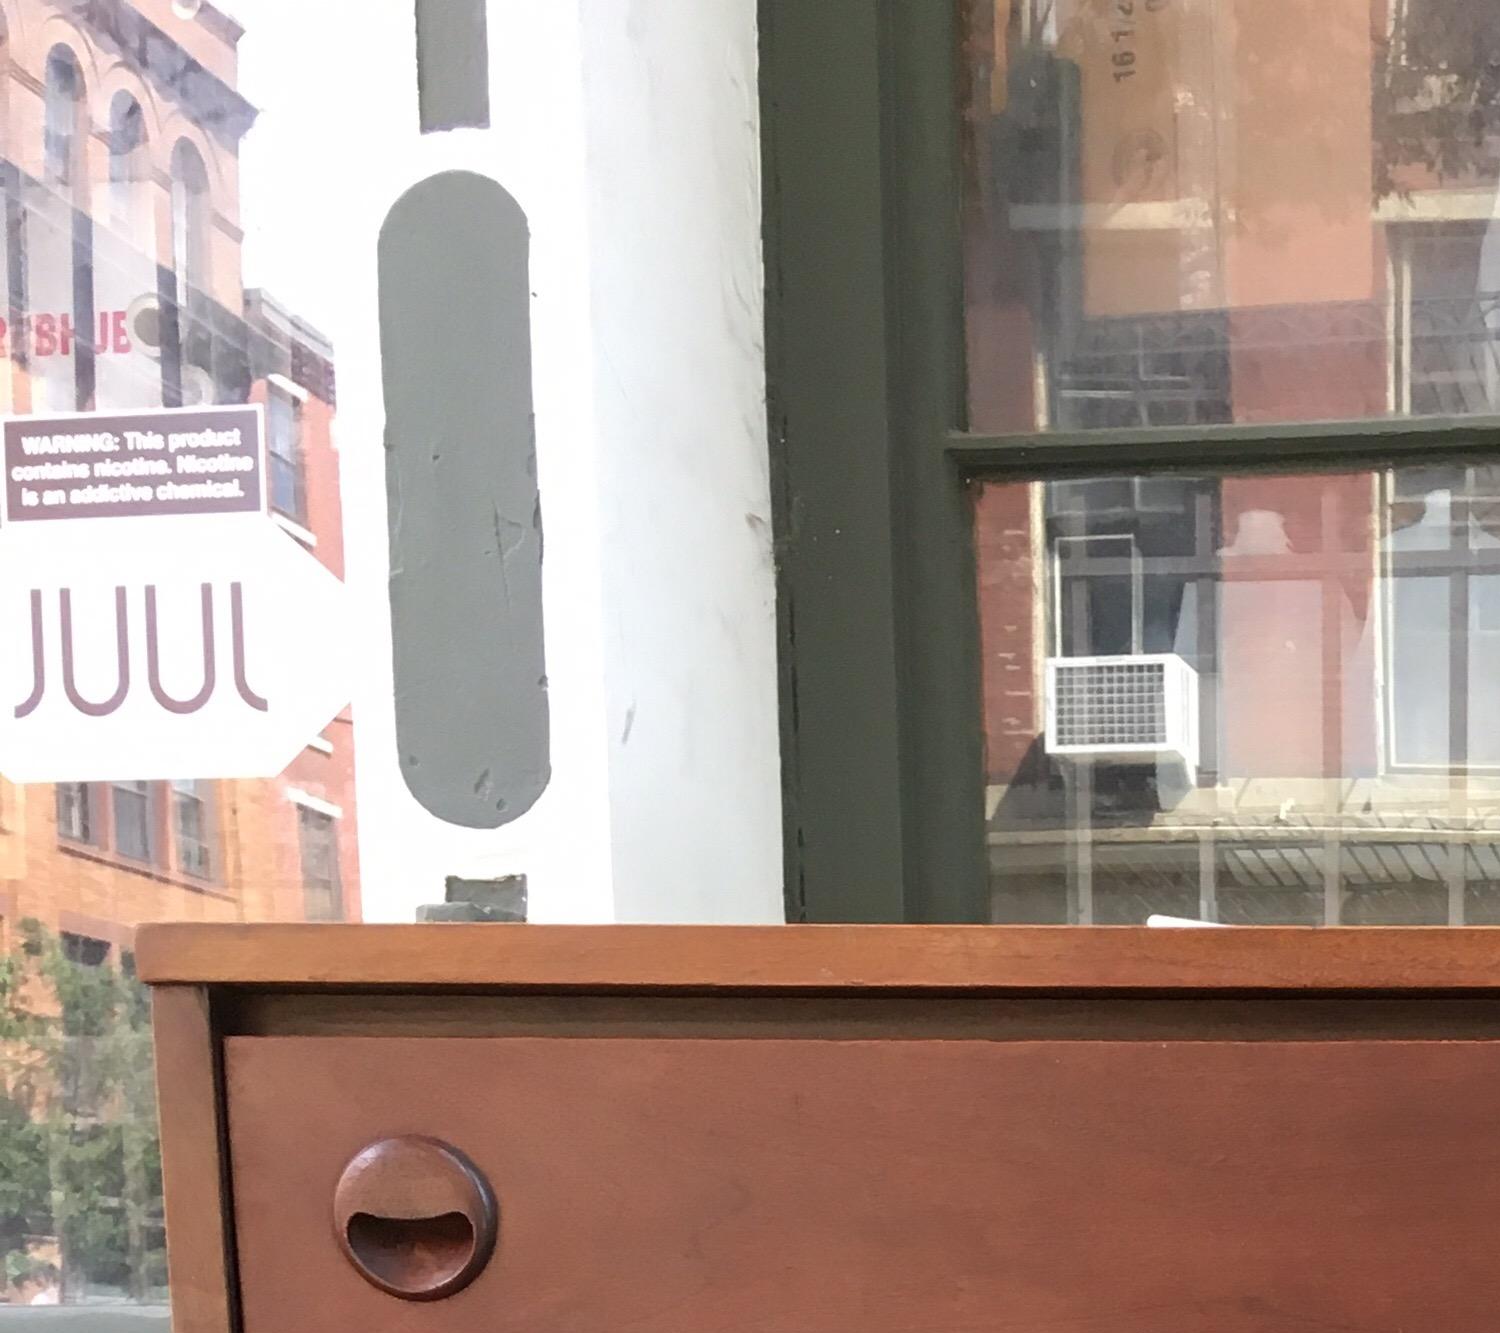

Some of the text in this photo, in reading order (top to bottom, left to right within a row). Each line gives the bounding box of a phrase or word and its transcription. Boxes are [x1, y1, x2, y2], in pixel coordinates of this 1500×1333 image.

[21, 427, 242, 455] WARNING: This product
[11, 453, 254, 482] contains nicotine. Nicotine
[21, 478, 245, 507] is an addictive chemical.
[14, 581, 268, 719] JUUL
